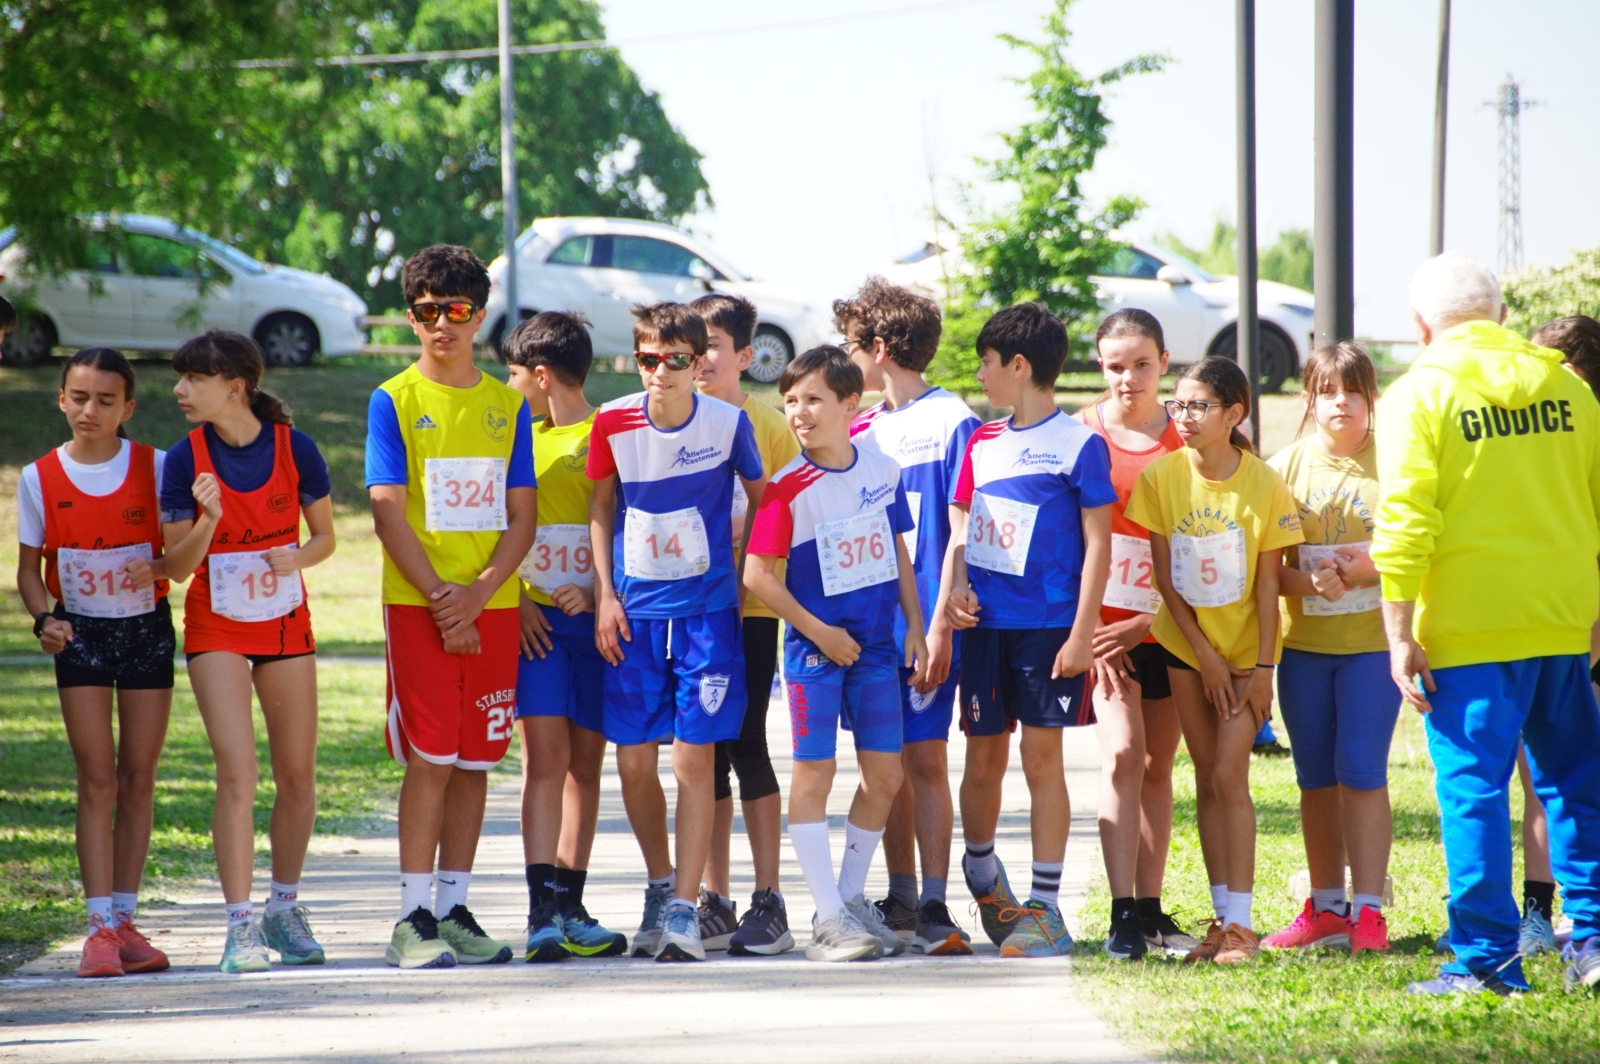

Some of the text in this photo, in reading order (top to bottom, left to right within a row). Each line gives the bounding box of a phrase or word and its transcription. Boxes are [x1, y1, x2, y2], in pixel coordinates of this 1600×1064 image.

[1460, 399, 1574, 442] GIUDICE
[686, 446, 714, 459] Atletica
[1028, 452, 1057, 460] Atletica
[444, 479, 495, 508] 324
[645, 532, 684, 560] 14
[973, 514, 1017, 550] 318
[534, 543, 593, 574] 319
[836, 532, 885, 569] 376
[241, 570, 279, 600] 19
[1107, 556, 1153, 590] 12
[1201, 557, 1218, 586] 5
